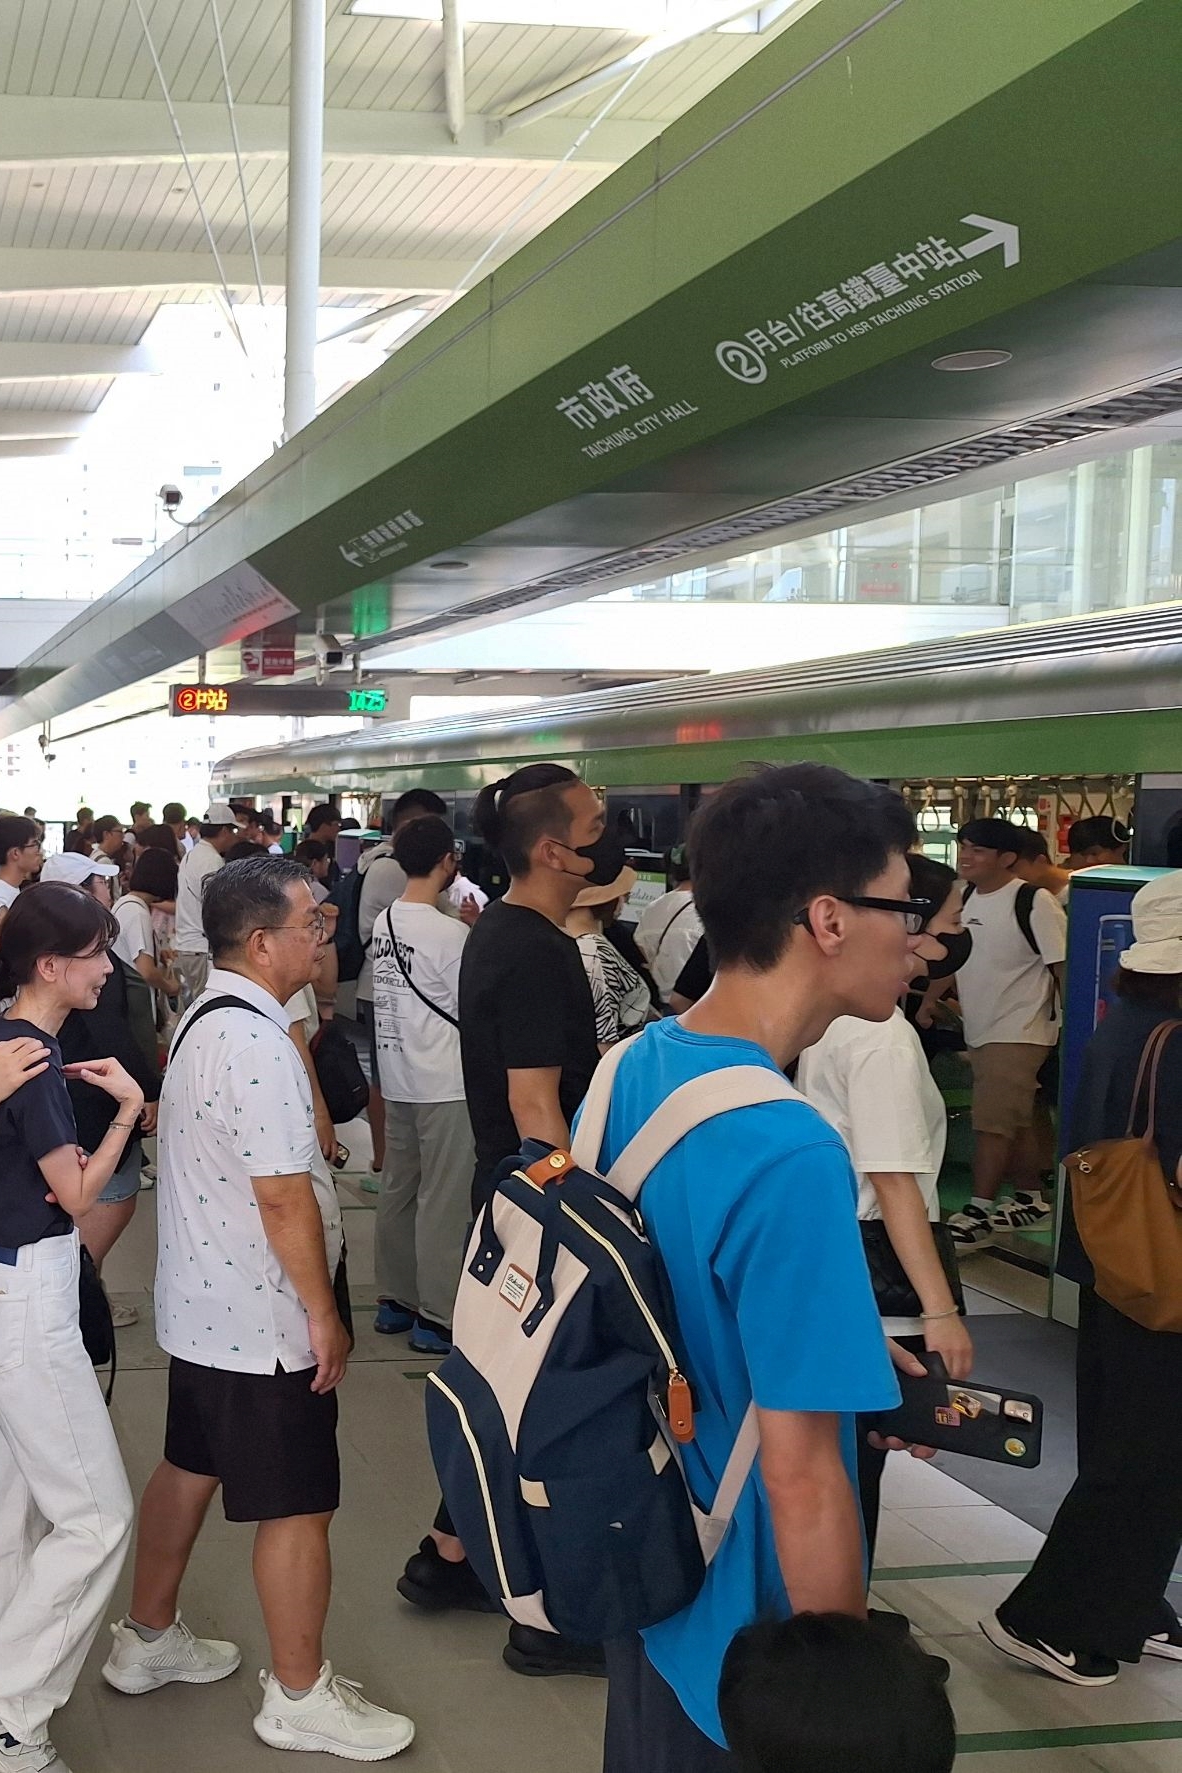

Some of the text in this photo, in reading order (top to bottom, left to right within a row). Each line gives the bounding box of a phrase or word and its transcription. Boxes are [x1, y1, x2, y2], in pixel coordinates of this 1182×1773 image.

[779, 269, 983, 369] PLATFORM TO HSR TAICHUNG STATION
[555, 364, 655, 430] 市政府
[581, 399, 699, 459] TAICHUNG CITY HALL
